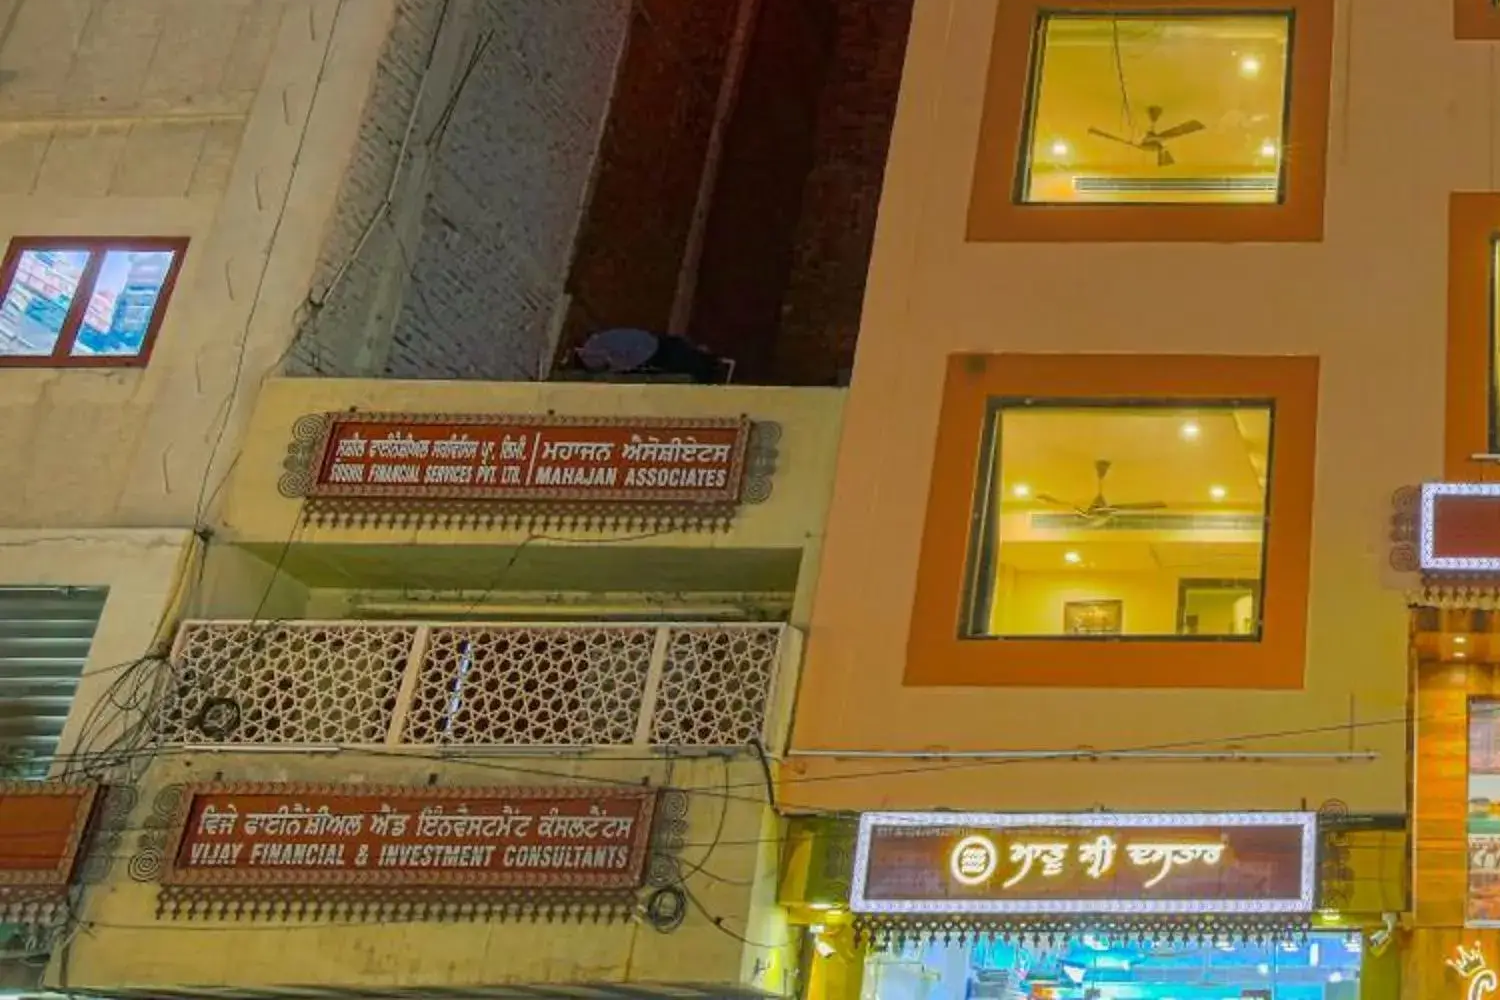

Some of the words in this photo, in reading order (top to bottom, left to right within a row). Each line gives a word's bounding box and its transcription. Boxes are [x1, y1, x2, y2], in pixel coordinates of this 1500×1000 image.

[542, 441, 614, 462] ਮਹਾਜਨ
[368, 463, 420, 483] FINANCIAL
[424, 464, 473, 483] SERVICES
[535, 466, 616, 487] MAHAJAN
[624, 467, 727, 488] ASSOCIATES
[370, 803, 411, 836] ਐਂਡ
[190, 843, 243, 865] VIJAY
[249, 843, 345, 865] FINANCIAL
[354, 844, 369, 866] &
[379, 844, 496, 867] INVESTMENT
[503, 845, 628, 869] CONSULTANTS
